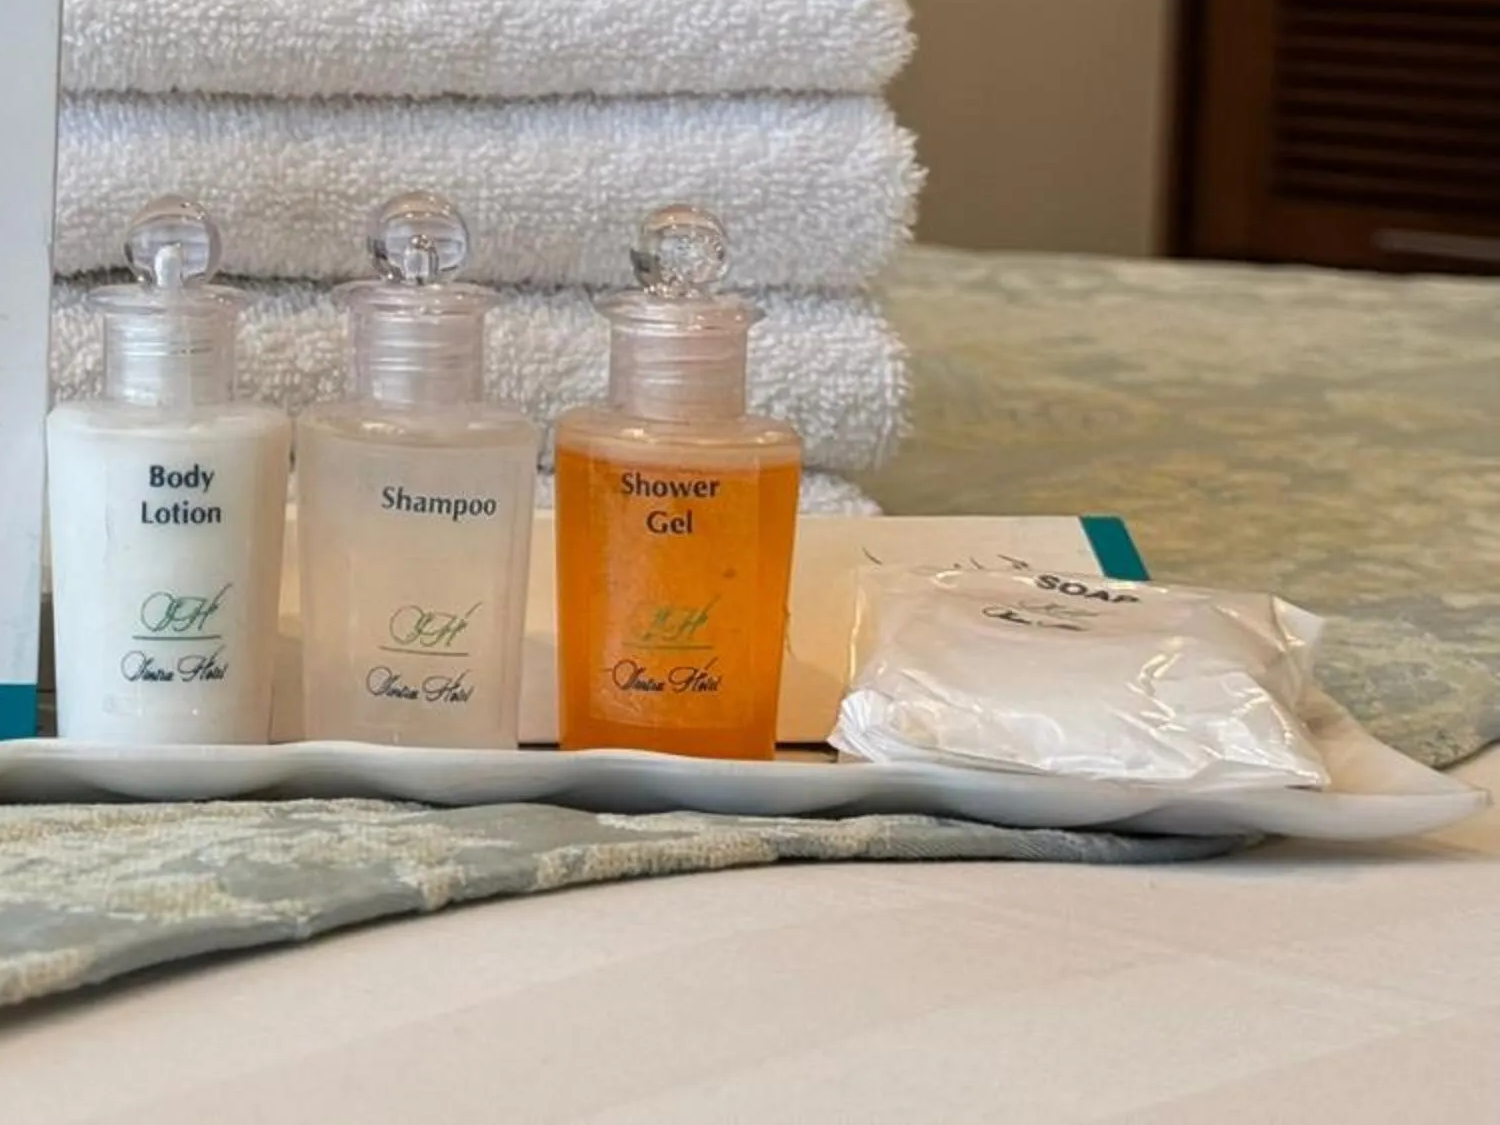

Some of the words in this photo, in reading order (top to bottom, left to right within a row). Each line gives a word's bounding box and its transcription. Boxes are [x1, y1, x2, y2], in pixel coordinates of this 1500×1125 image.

[149, 463, 215, 493] Body
[621, 472, 721, 499] Shower
[141, 500, 222, 525] Lotion
[381, 486, 497, 522] Shampoo
[646, 509, 694, 535] Gel
[1034, 574, 1140, 604] SOAP
